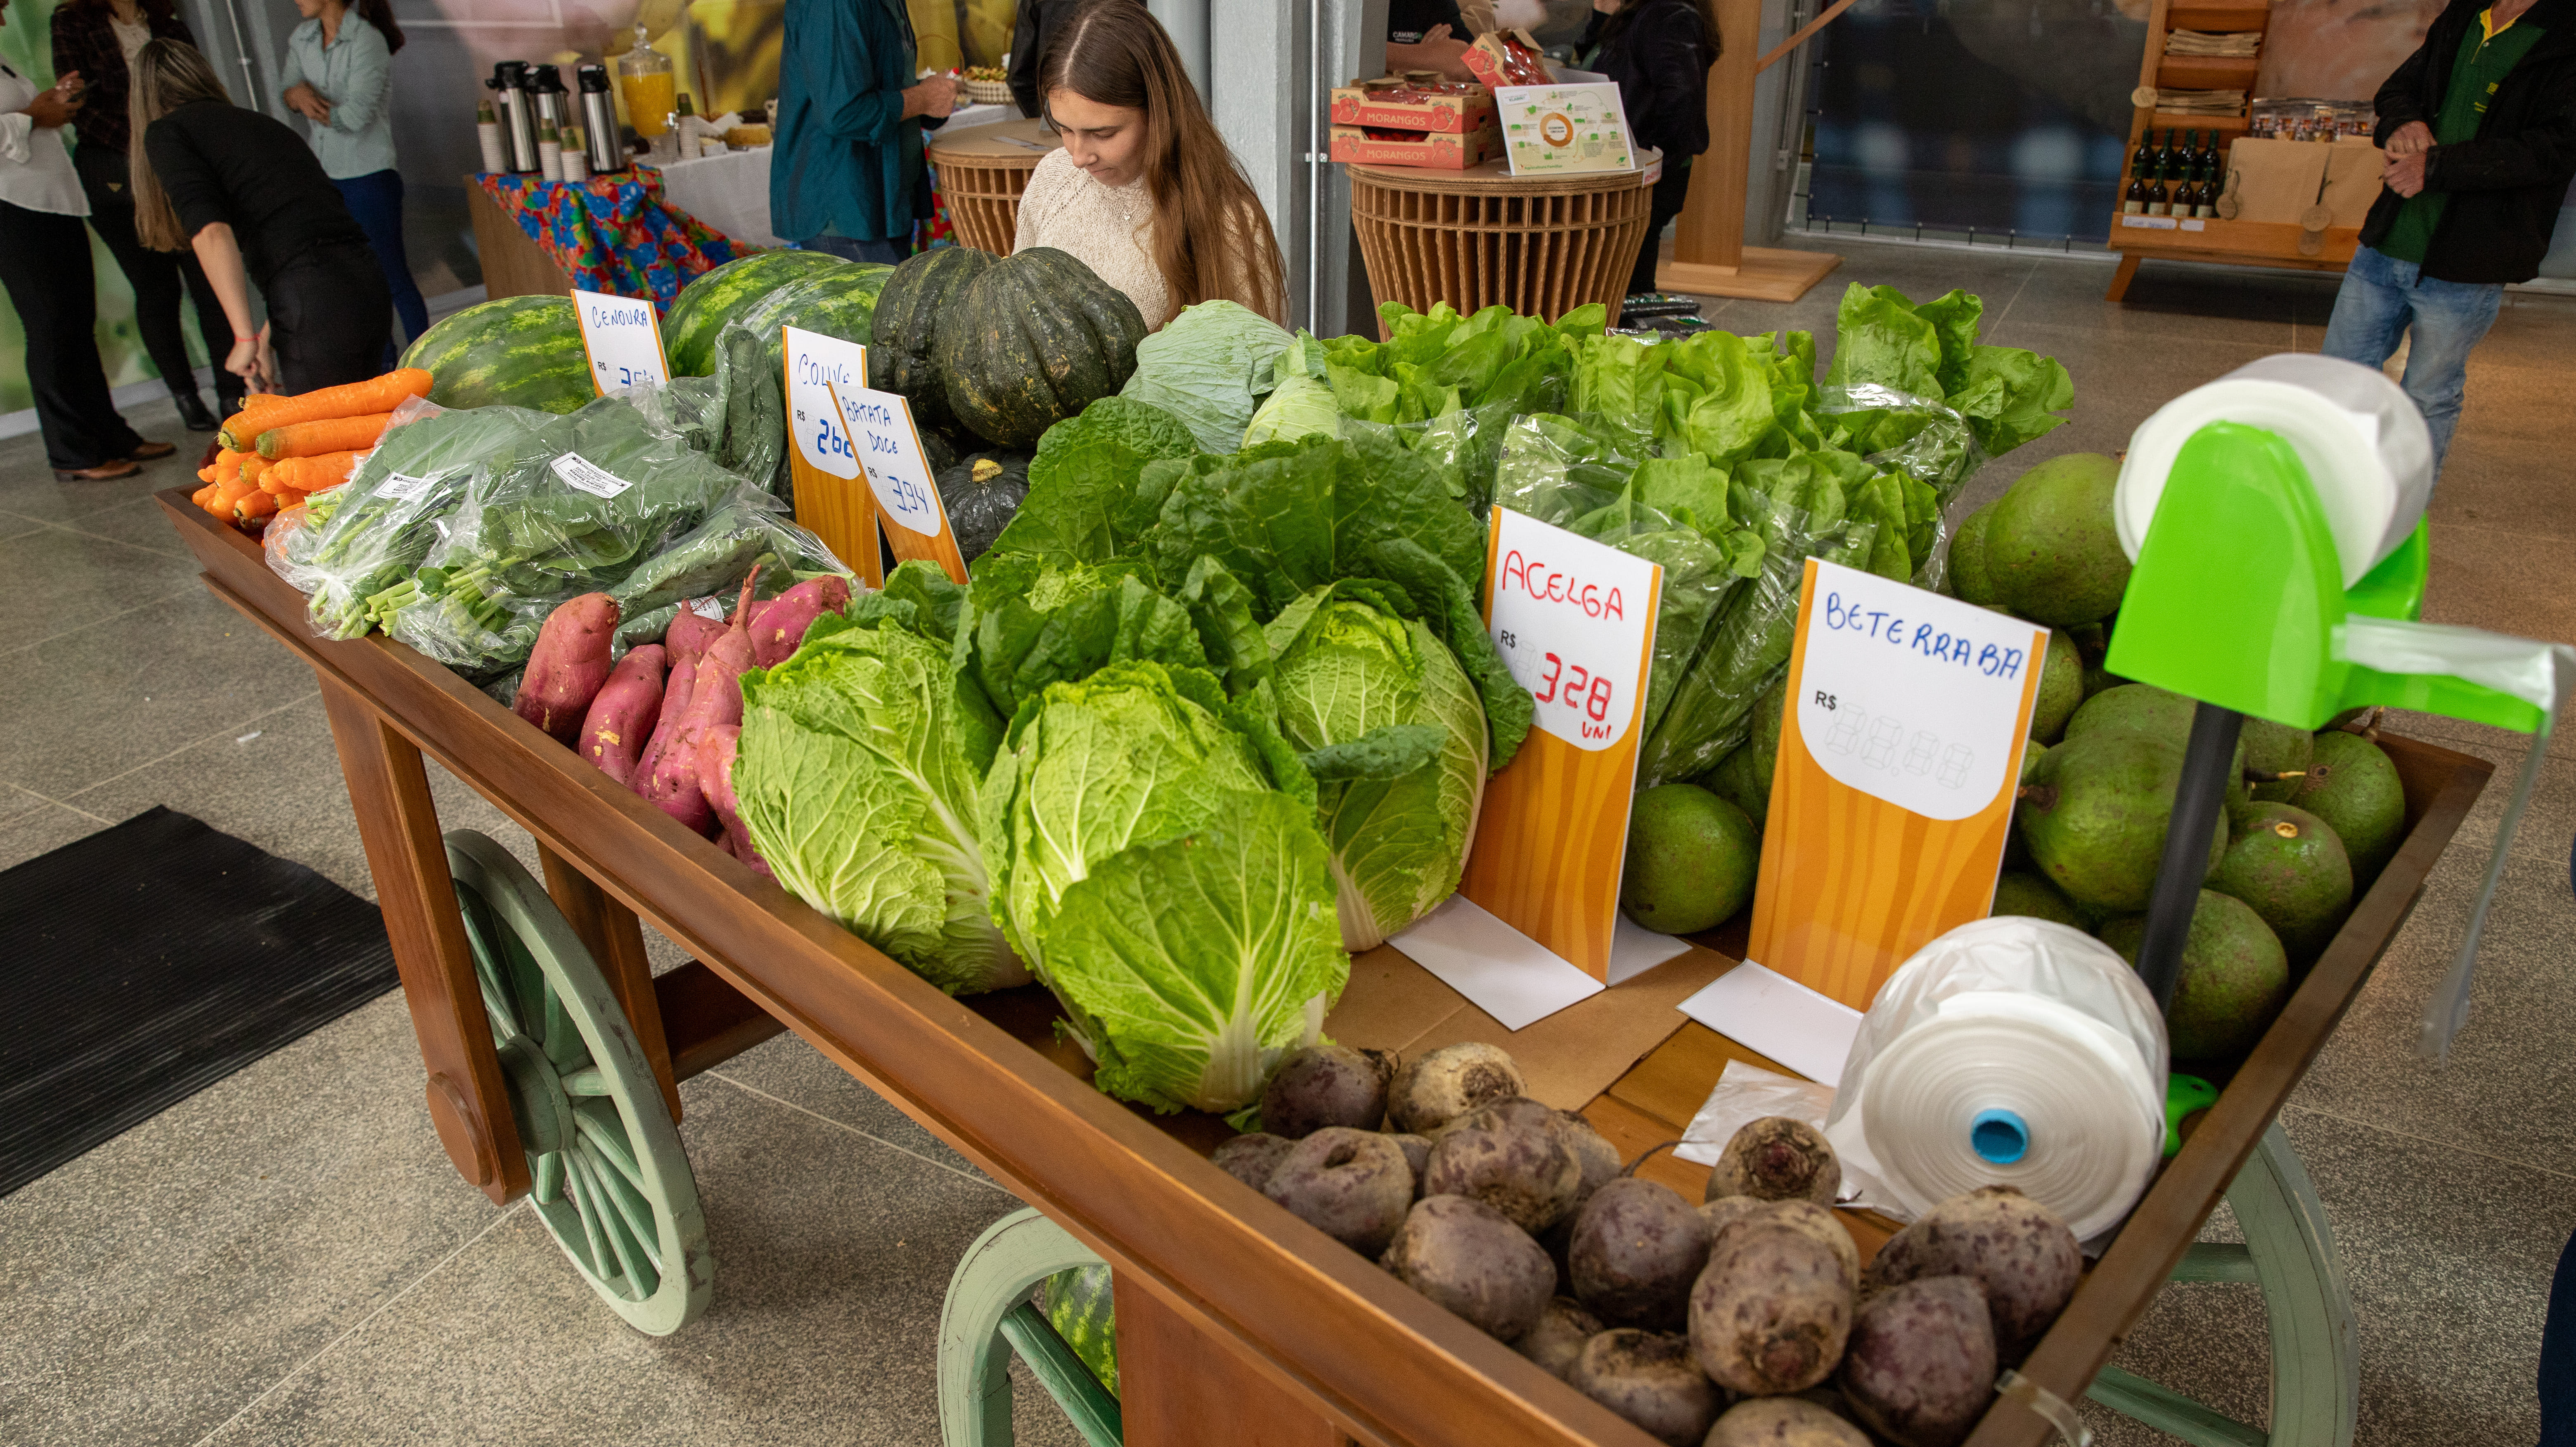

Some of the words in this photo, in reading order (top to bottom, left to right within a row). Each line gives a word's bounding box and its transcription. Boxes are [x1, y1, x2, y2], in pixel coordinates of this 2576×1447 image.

[1367, 113, 1425, 126] MORANGOS
[1366, 149, 1426, 161] MORANGOS
[592, 306, 648, 328] CENOURA
[598, 361, 606, 371] R$
[797, 410, 805, 422] R$
[842, 396, 892, 427] BATATA
[867, 426, 898, 454] DOCE
[569, 469, 585, 481] Santos
[868, 467, 878, 479] R$
[888, 476, 929, 515] 3,94
[1503, 550, 1623, 621] ACELGA
[1827, 592, 2023, 680] BETERRABA
[1501, 630, 1516, 648] R$
[1535, 652, 1612, 721] 328
[1815, 690, 1837, 711] R$
[1582, 721, 1612, 739] UNI
